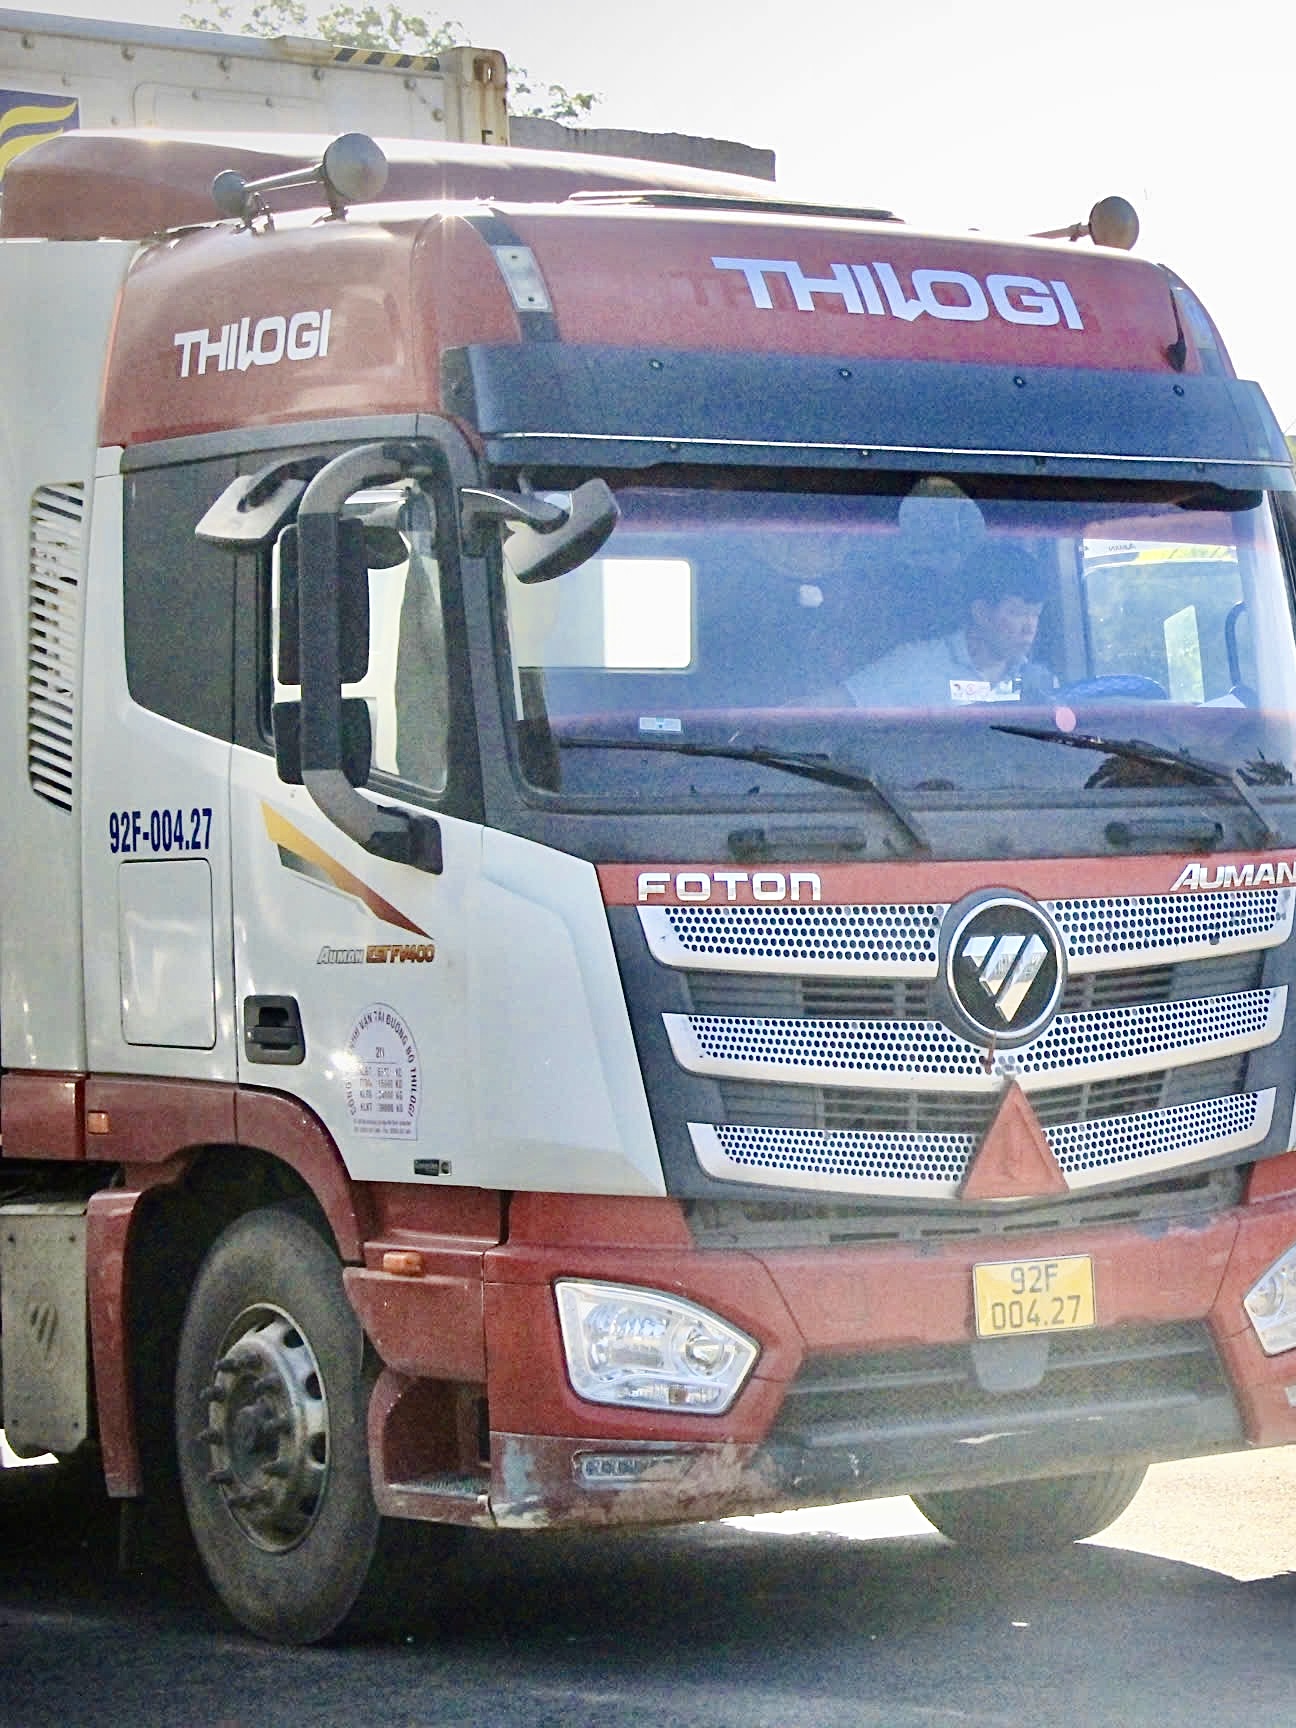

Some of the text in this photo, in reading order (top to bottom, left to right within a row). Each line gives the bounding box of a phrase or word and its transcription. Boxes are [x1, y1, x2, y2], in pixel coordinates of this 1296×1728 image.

[711, 256, 1085, 331] THILOGI
[174, 308, 332, 378] THILOGI
[109, 808, 212, 853] 92F-004.27
[637, 872, 821, 901] FOTON
[316, 945, 364, 965] AUMAN
[1010, 1263, 1058, 1294] 92F
[991, 1294, 1081, 1330] 004.27
